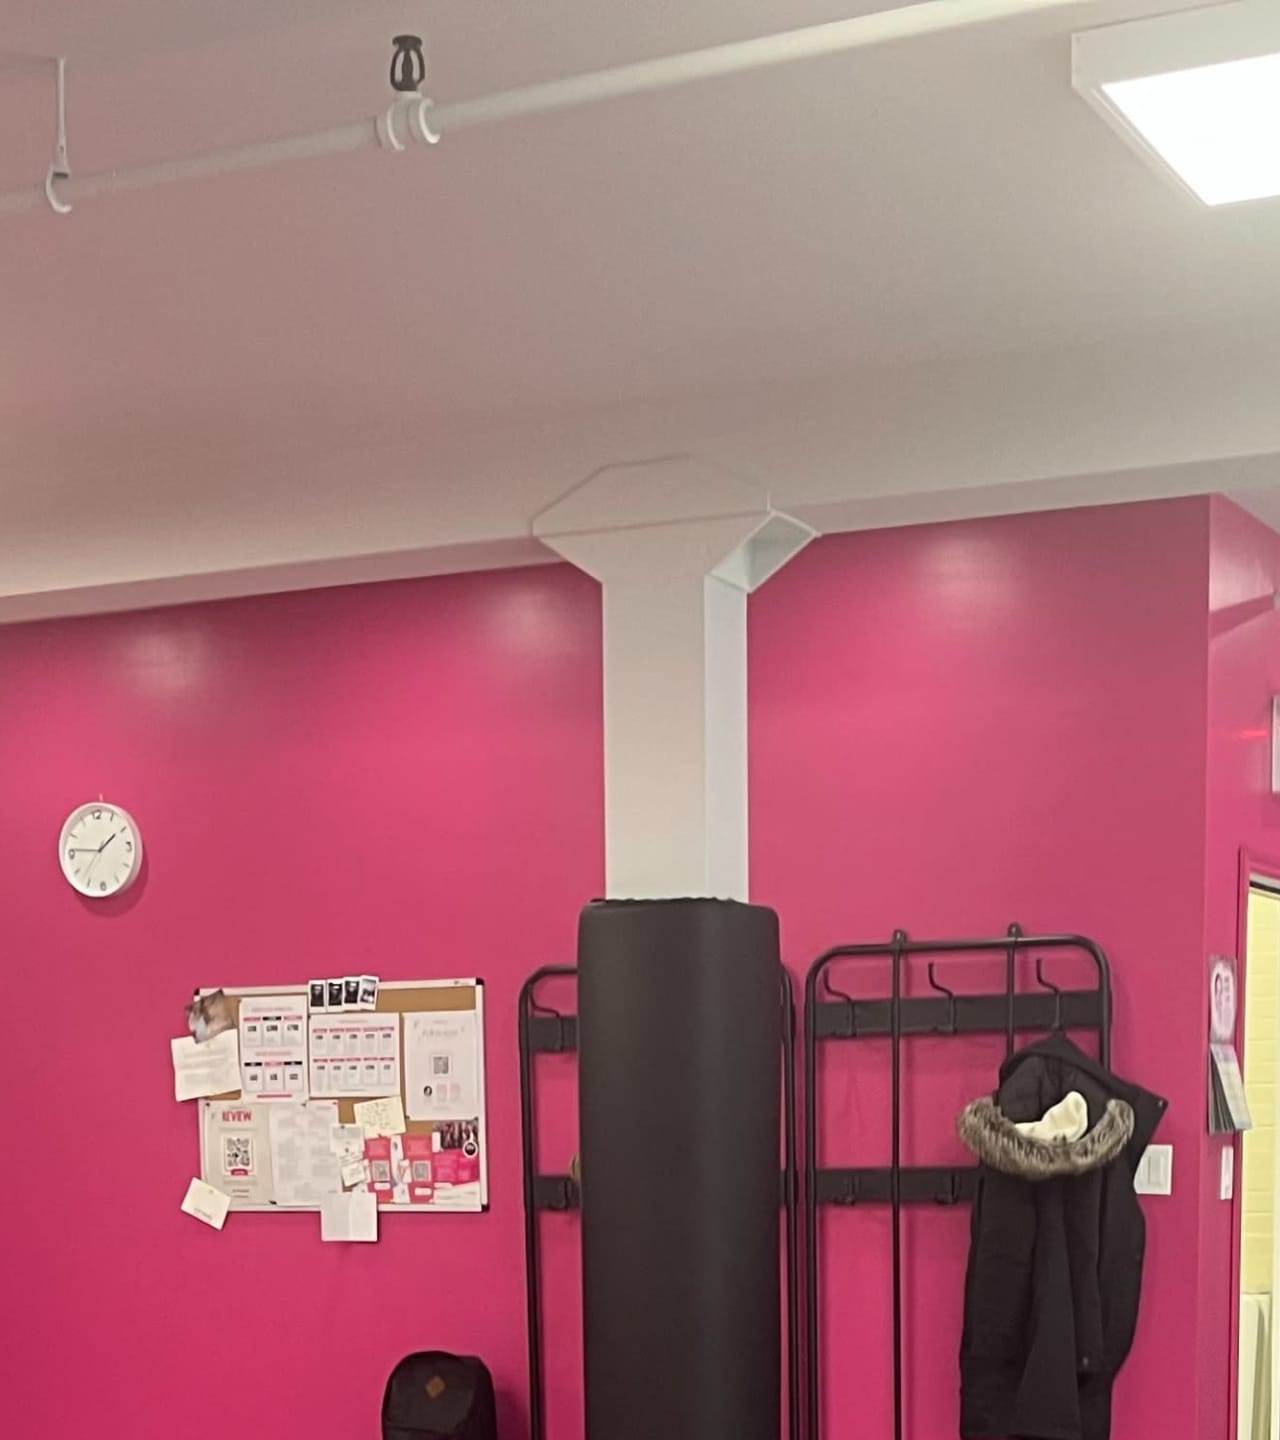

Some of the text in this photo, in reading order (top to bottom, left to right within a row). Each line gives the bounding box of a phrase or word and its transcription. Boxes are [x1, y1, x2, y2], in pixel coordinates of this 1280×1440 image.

[91, 809, 102, 820] 12
[100, 881, 106, 891] 6
[222, 1110, 252, 1122] REVIEW
